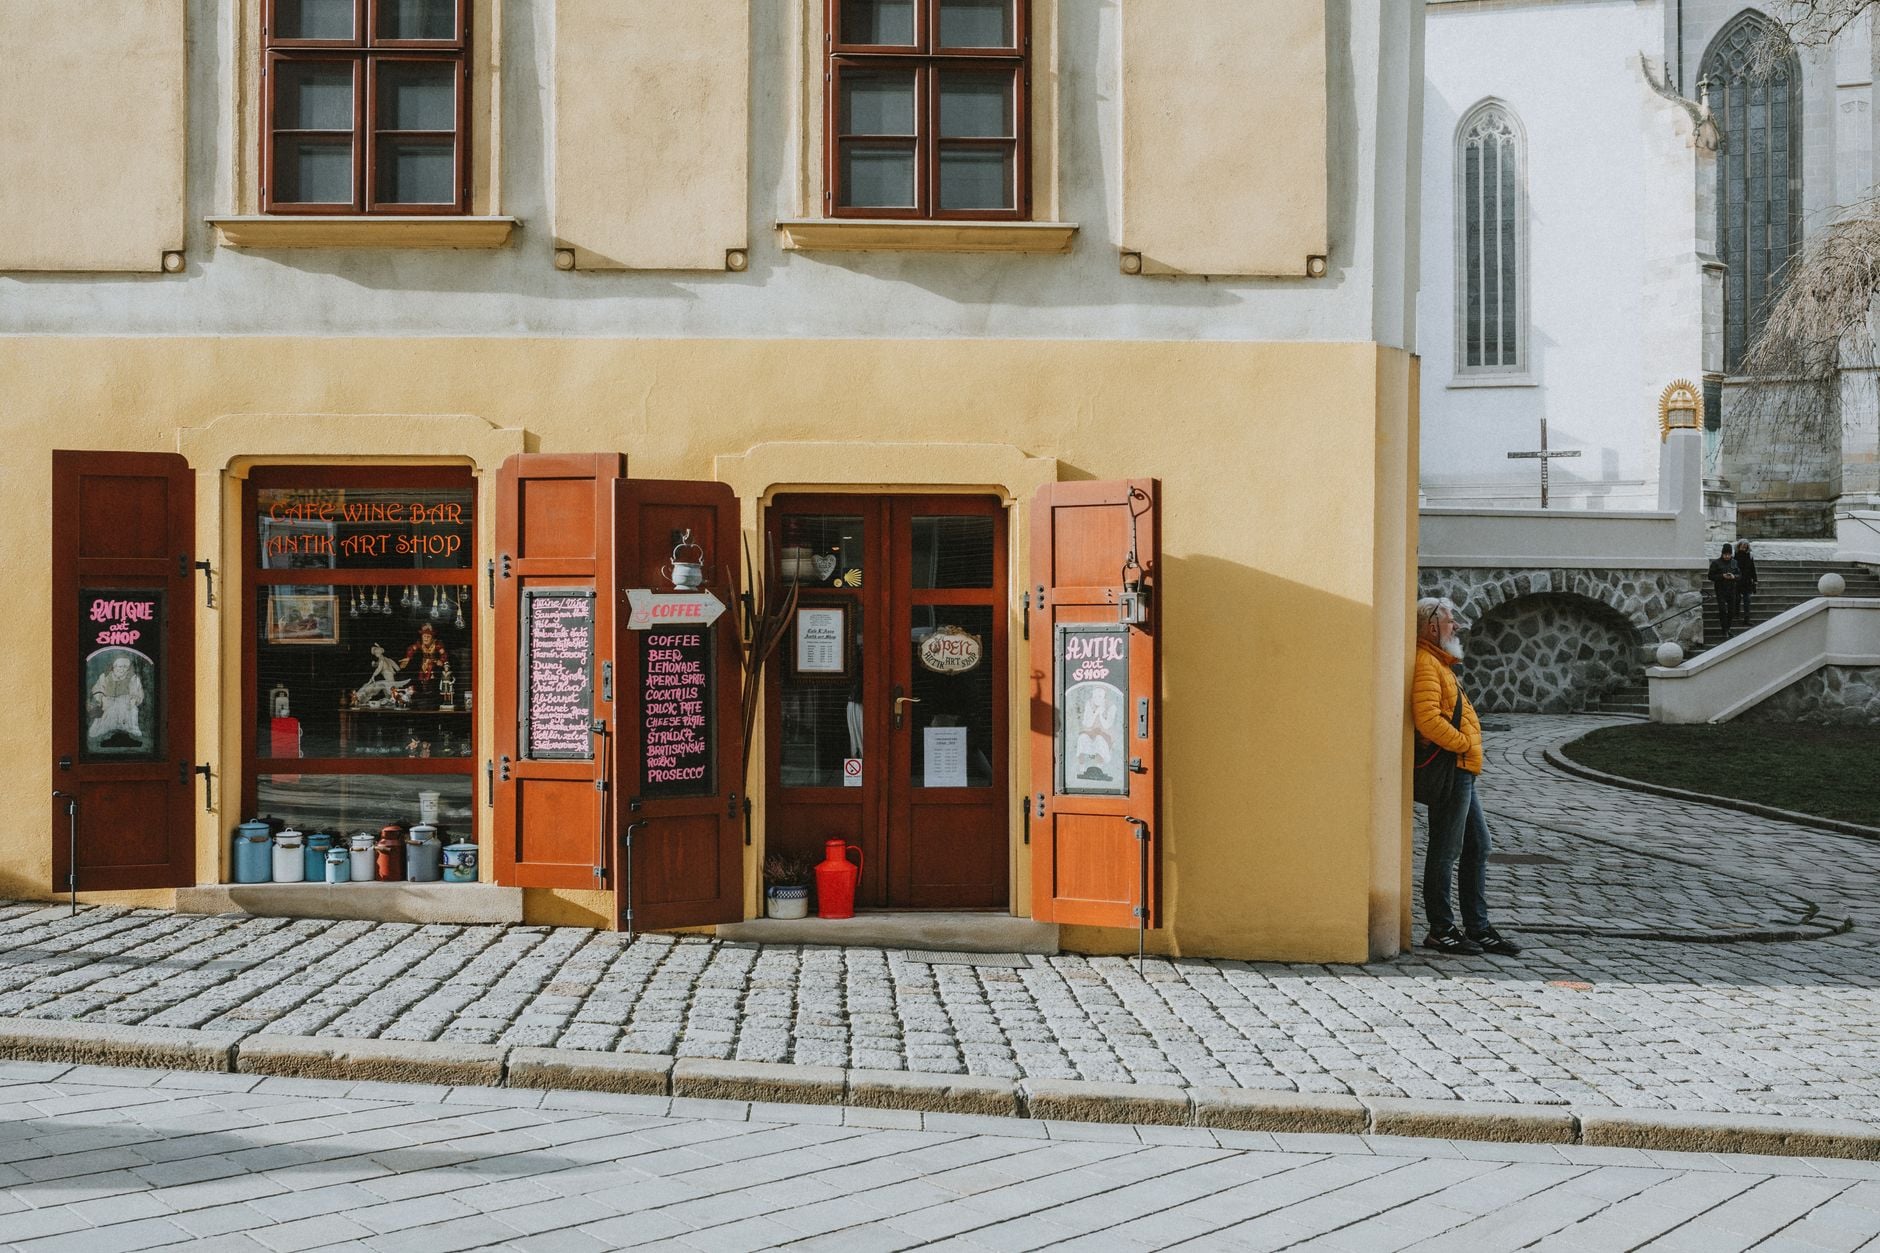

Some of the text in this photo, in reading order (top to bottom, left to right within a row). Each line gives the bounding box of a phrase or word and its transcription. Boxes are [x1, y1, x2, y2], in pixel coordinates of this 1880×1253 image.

[270, 503, 464, 525] CAFE WINE BAR
[266, 533, 461, 557] ANTIK ART SHOP
[89, 598, 155, 623] ANTIQUE
[651, 603, 702, 618] COFFEE
[109, 620, 130, 632] art
[95, 629, 140, 645] SHOP
[648, 635, 701, 647] COFFEE
[647, 649, 683, 662] BEER
[923, 651, 945, 669] ANTIK
[944, 656, 961, 666] ART
[532, 660, 566, 675] Dunaj
[648, 661, 701, 674] LEMONADE
[1082, 658, 1104, 669] art
[646, 674, 682, 689] APEROL
[1072, 668, 1110, 681] SHOP
[532, 692, 581, 704] Alibernet
[645, 687, 698, 702] COCKTAILS
[646, 701, 703, 716] DUCK PATE
[646, 716, 681, 728] CHEESE
[647, 765, 705, 783] PROSECCO
